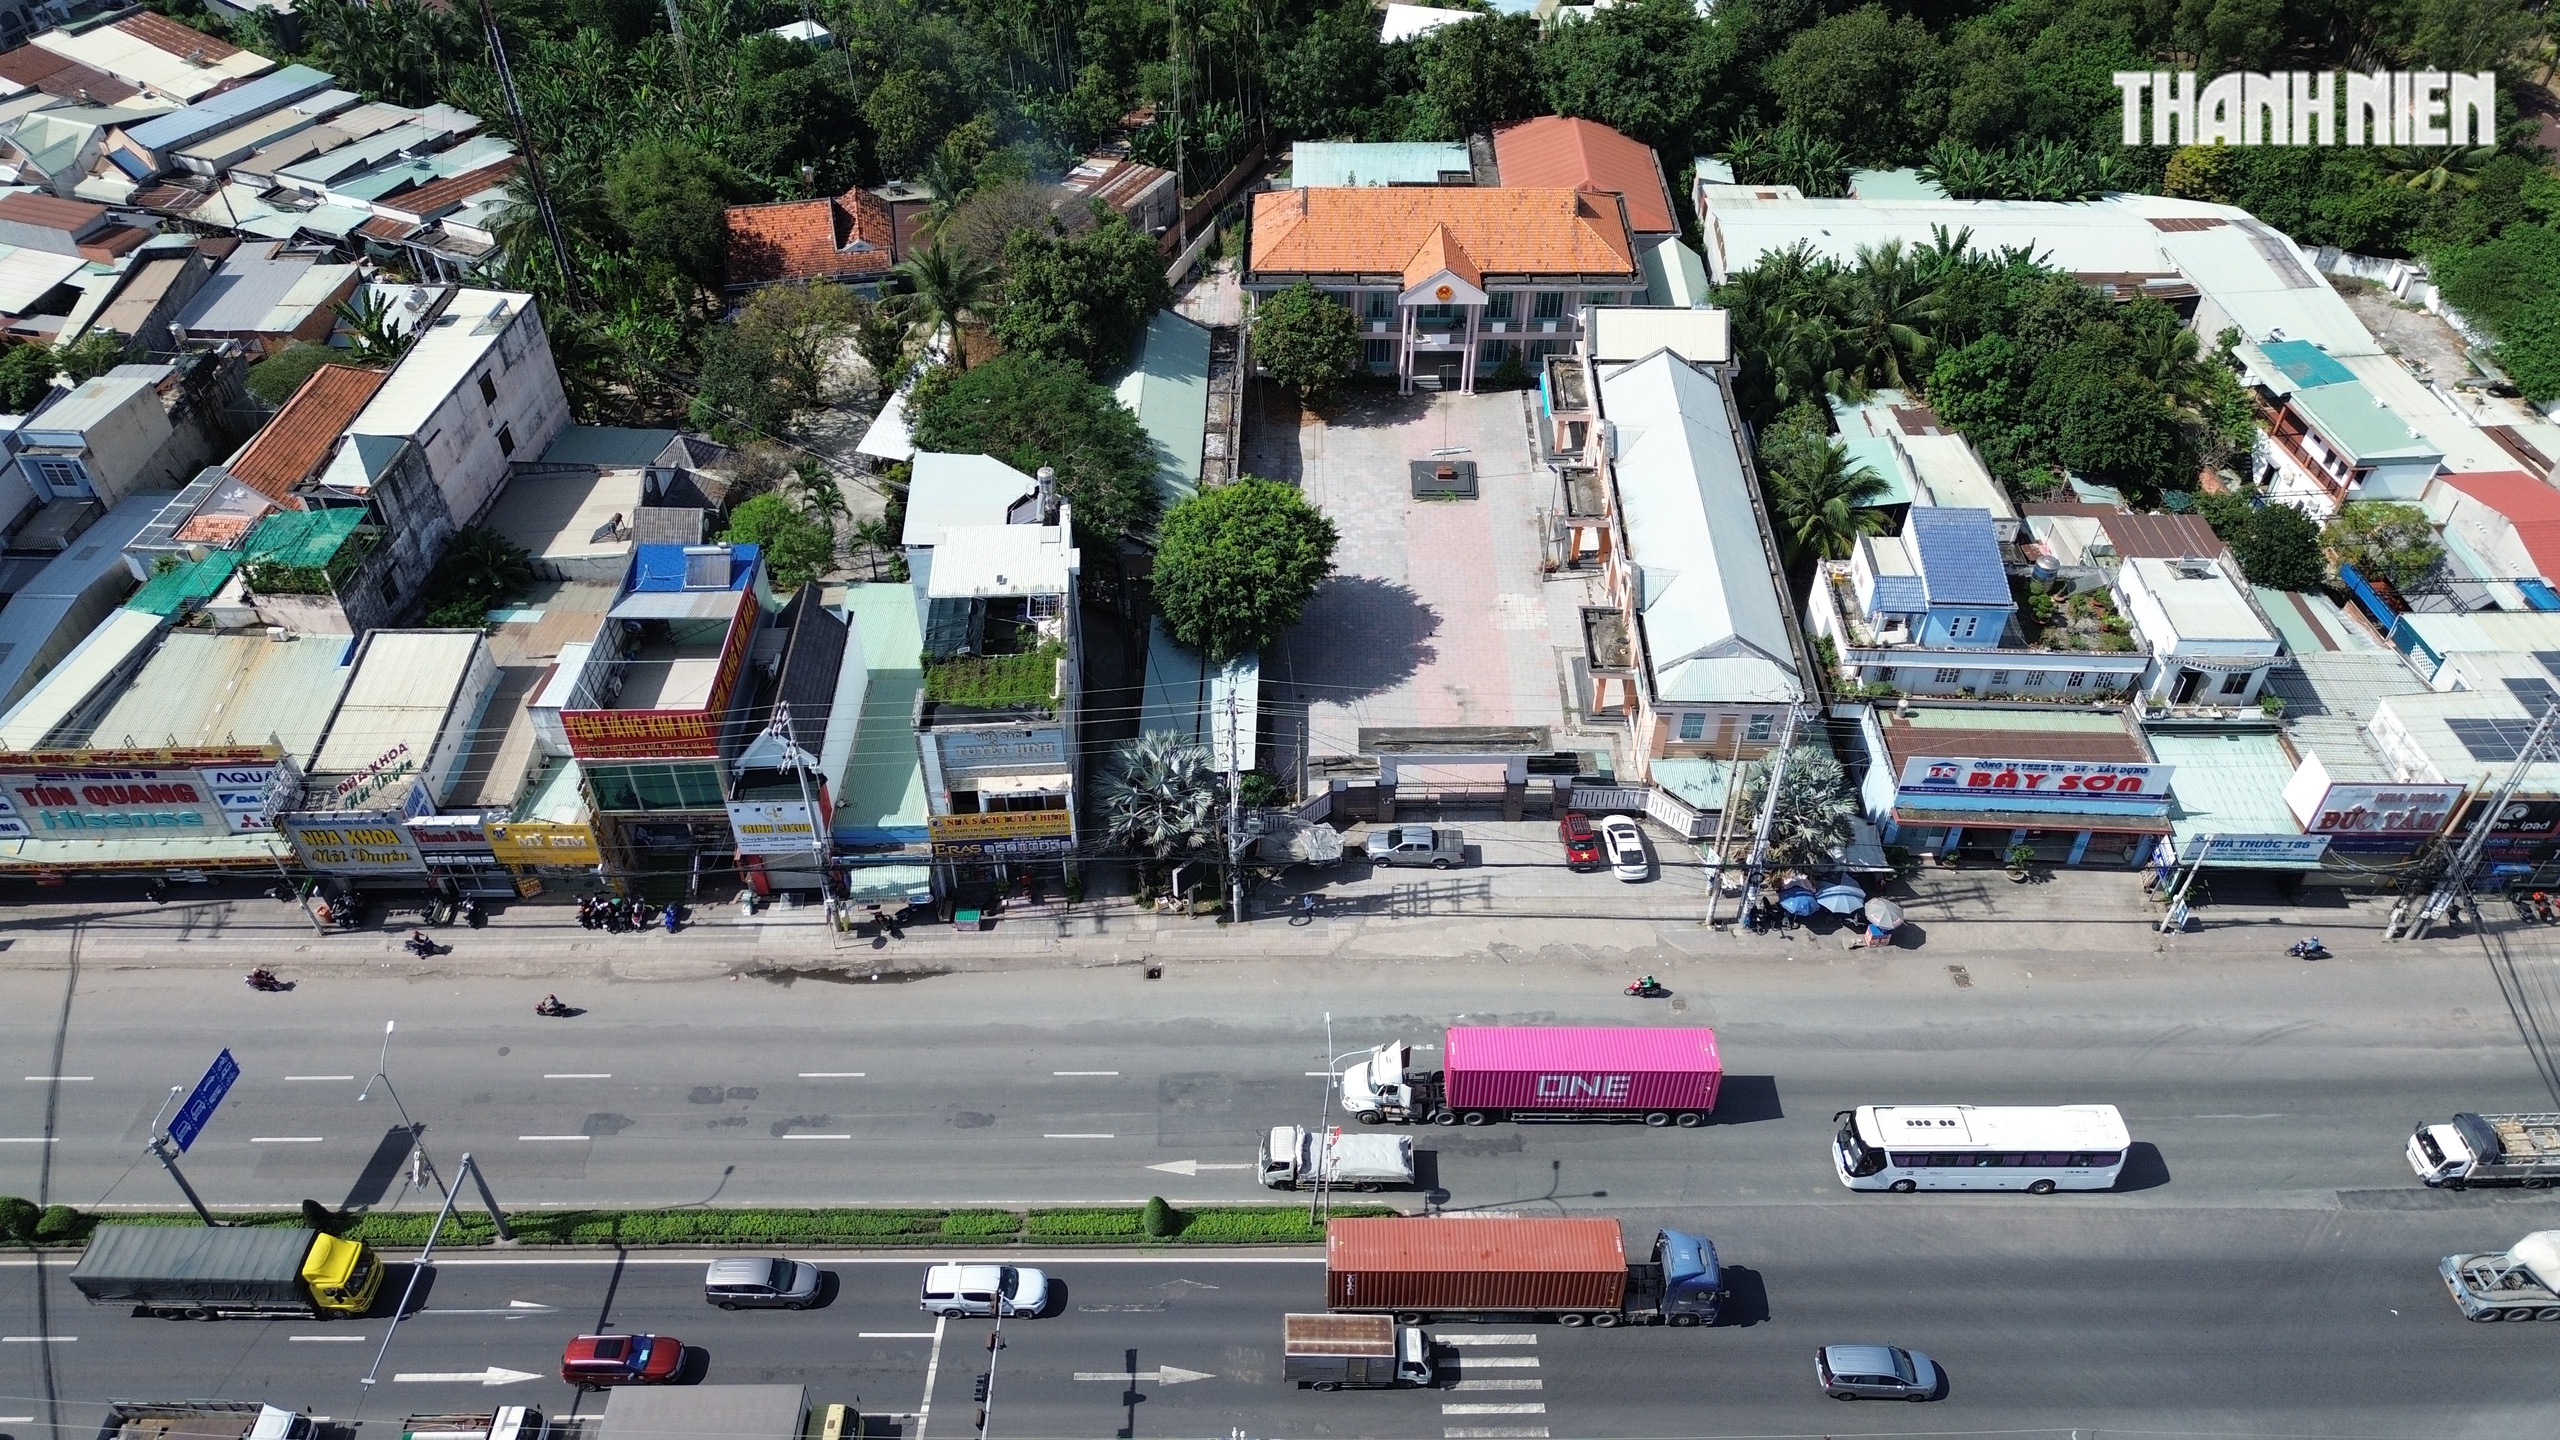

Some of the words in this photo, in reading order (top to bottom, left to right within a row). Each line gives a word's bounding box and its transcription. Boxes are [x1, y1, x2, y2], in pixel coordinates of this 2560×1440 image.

[565, 712, 605, 741] TIỆM
[647, 715, 677, 738] KIM
[677, 715, 708, 737] MAI
[337, 769, 368, 795] NHA
[368, 742, 408, 774] KHOA
[1967, 768, 2049, 789] BẢY
[1974, 760, 2003, 770] CÔNG
[2020, 763, 2049, 771] TNHH
[2050, 764, 2066, 772] TM
[2073, 765, 2089, 773] DV
[2096, 764, 2117, 773] XÂY
[2119, 767, 2149, 776] DỰNG
[15, 783, 78, 807] TÍN
[82, 783, 200, 807] QUANG
[39, 809, 204, 830] Hisense
[2316, 803, 2380, 830] ĐỨC
[2465, 820, 2510, 831] ipne
[299, 829, 344, 847] NHA
[345, 828, 402, 845] KHOA
[548, 835, 588, 847] KIM
[2239, 838, 2283, 849] THUỐC
[2286, 840, 2311, 849] 186
[1537, 1075, 1631, 1097] ONE
